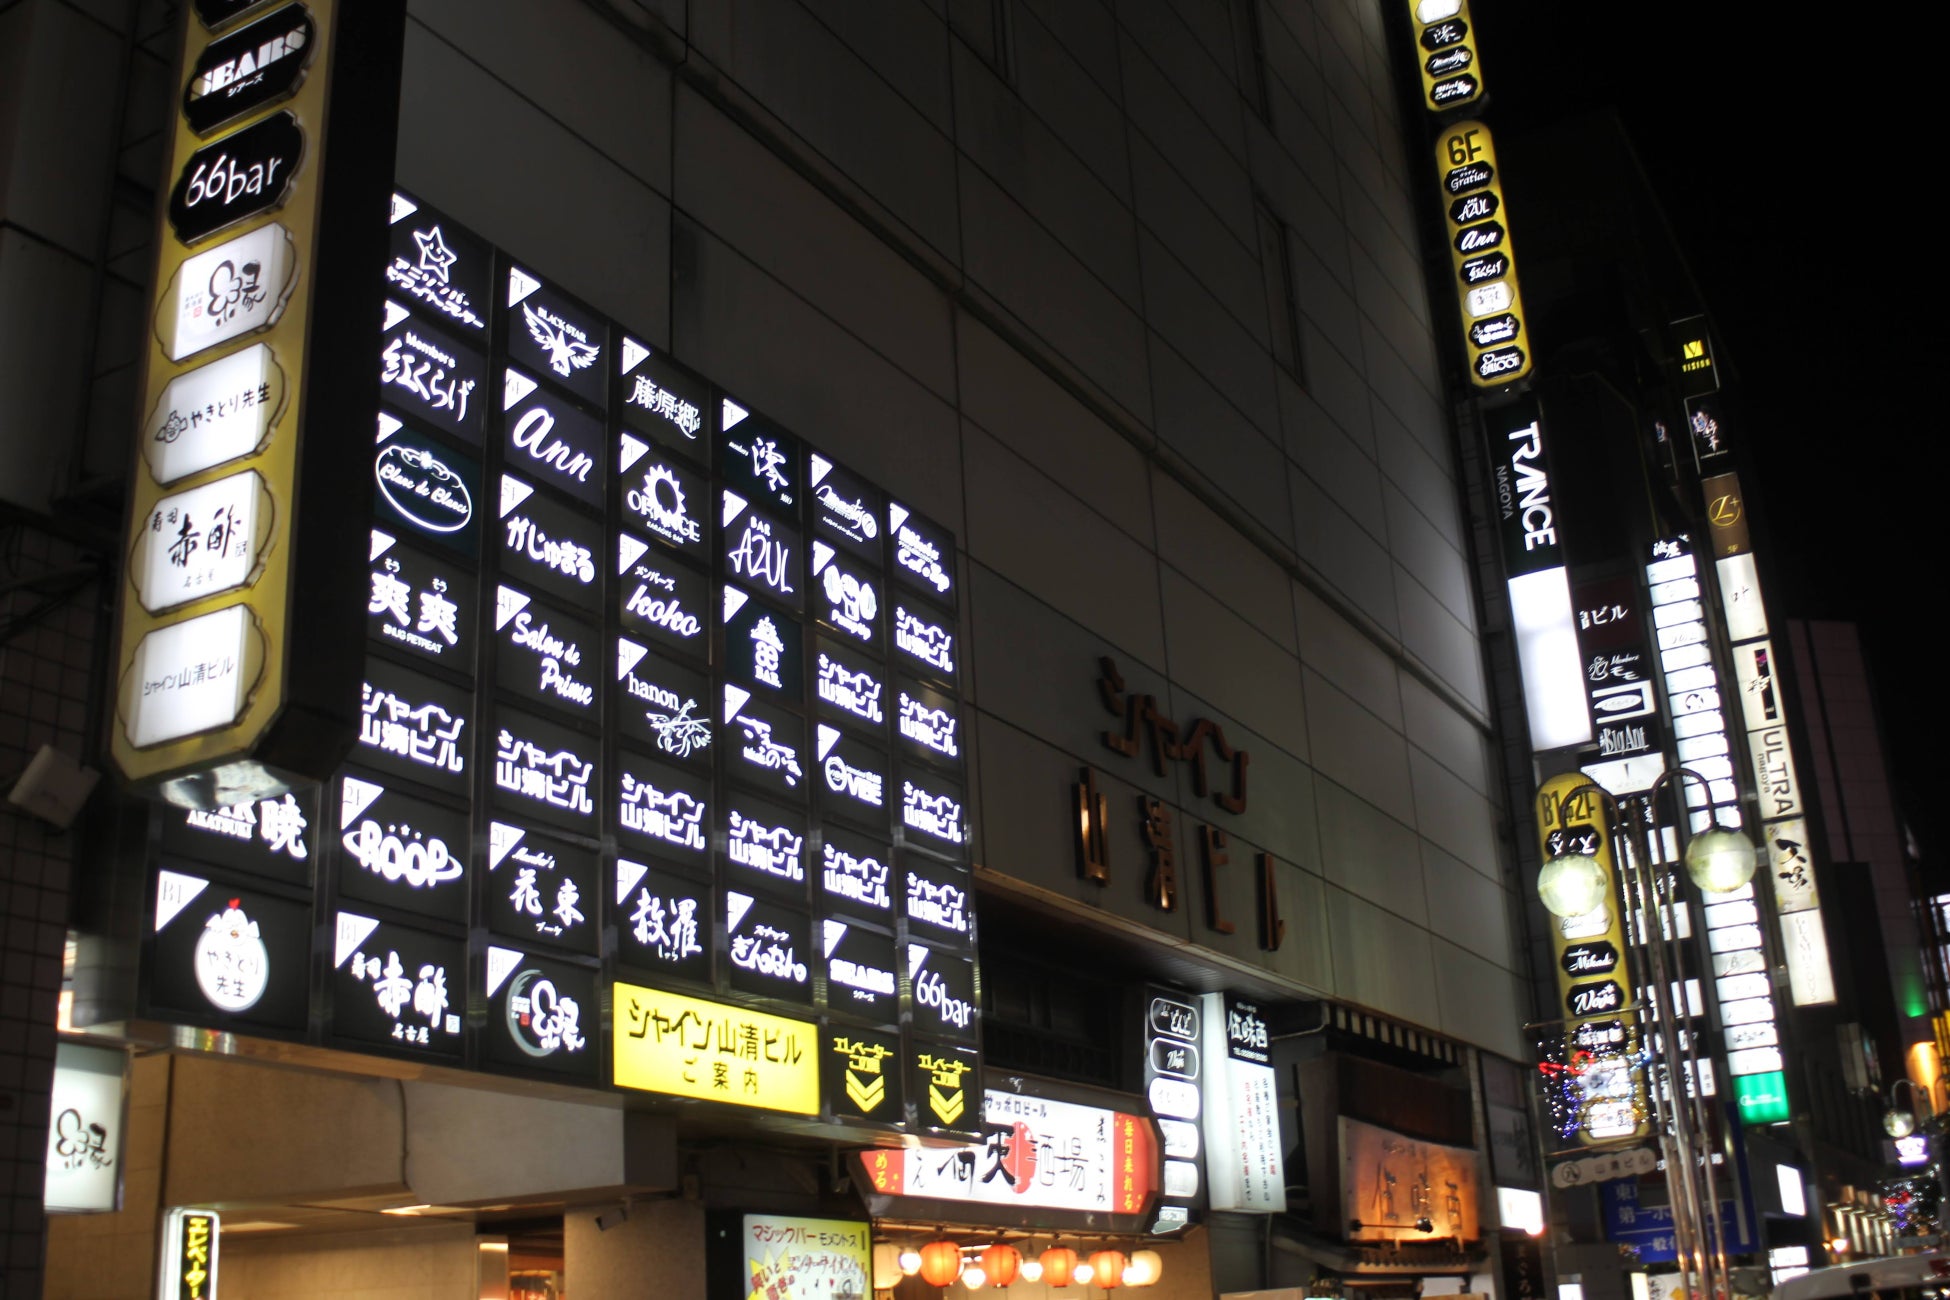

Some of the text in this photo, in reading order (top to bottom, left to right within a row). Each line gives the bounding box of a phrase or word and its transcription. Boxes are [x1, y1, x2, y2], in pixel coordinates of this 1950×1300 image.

[191, 25, 306, 101] SEARS
[228, 73, 264, 96] シアーズ
[1447, 129, 1482, 166] 6F
[185, 154, 282, 207] 66bar
[538, 307, 586, 344] BLACK STAR
[191, 382, 271, 428] やきとり先生
[1496, 465, 1514, 520] NAGOYA
[1508, 421, 1557, 551] TRANCE
[750, 515, 770, 537] BAR
[385, 557, 400, 572] そう
[507, 516, 595, 583] がじゅまる
[432, 578, 447, 593] そう
[626, 584, 701, 636] koko
[896, 606, 951, 651] シャイン
[511, 612, 581, 667] Salon de
[144, 655, 234, 696] シャイン山清ビル
[540, 657, 593, 705] Prime
[628, 671, 680, 711] hanon
[818, 653, 881, 700] シャイン
[362, 683, 464, 740] シャイン
[900, 692, 956, 735] シャイン
[359, 713, 464, 772] 山清ビル
[497, 730, 593, 785] シャイン
[1096, 656, 1248, 814] シャイン
[496, 761, 592, 814] 山清ビル
[1763, 730, 1794, 815] ULTRA
[620, 773, 705, 822] シャイン
[903, 781, 960, 821] シャイン
[187, 809, 252, 838] AKATSUKI
[620, 802, 706, 850] 山清ビル
[729, 811, 802, 855] シャイン
[360, 820, 450, 887] ROOP
[824, 843, 889, 885] シャイン
[908, 872, 965, 908] シャイン
[754, 924, 789, 941] スナック
[207, 948, 258, 975] やきとり
[830, 958, 895, 995] SEARS
[216, 975, 246, 998] 先生
[916, 970, 972, 1028] 66bar
[392, 1023, 429, 1044] 名古屋
[628, 999, 802, 1066] シャイン山清ビル
[683, 1059, 758, 1095] ご案内
[985, 1094, 1048, 1118] サッポロビール
[753, 1224, 816, 1243] マジックバー
[185, 1218, 208, 1300] エレベーター
